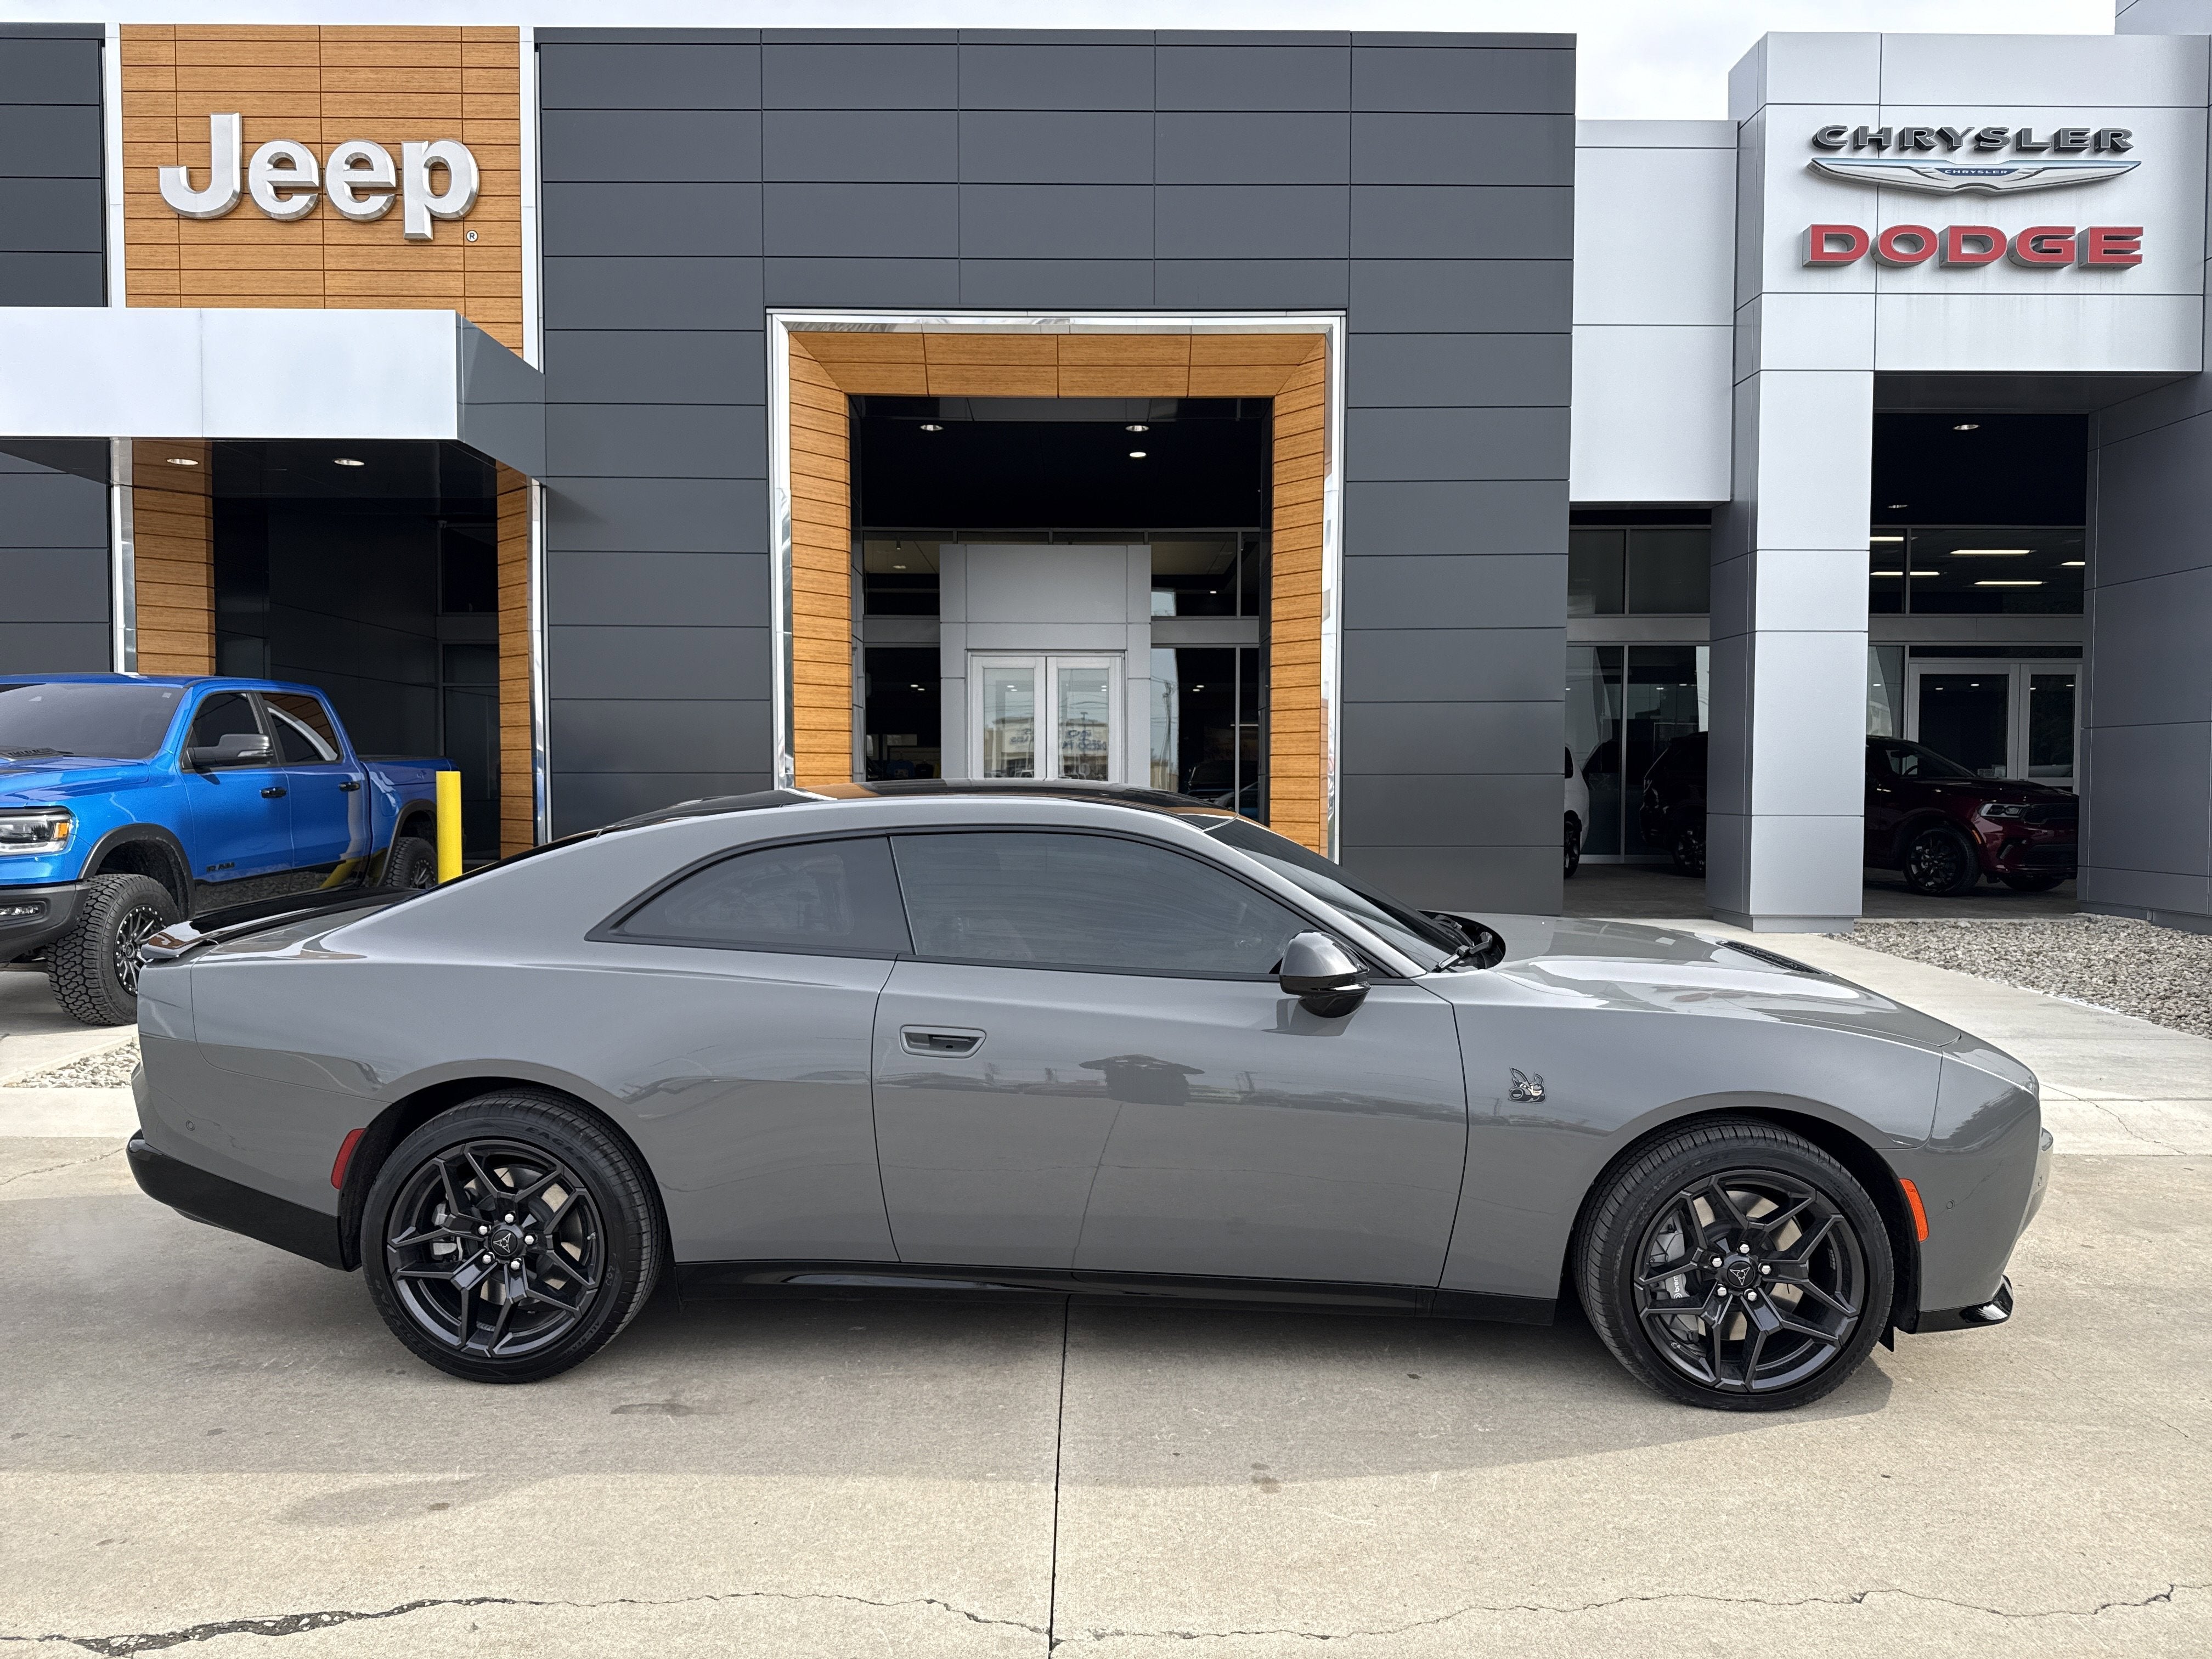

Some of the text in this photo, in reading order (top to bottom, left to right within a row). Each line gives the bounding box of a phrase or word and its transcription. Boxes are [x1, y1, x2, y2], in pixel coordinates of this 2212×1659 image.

[1811, 125, 2134, 153] CHRYSLER
[158, 112, 480, 241] Jeep
[1802, 224, 2144, 267] DODGE
[525, 1126, 588, 1165] EAGLE
